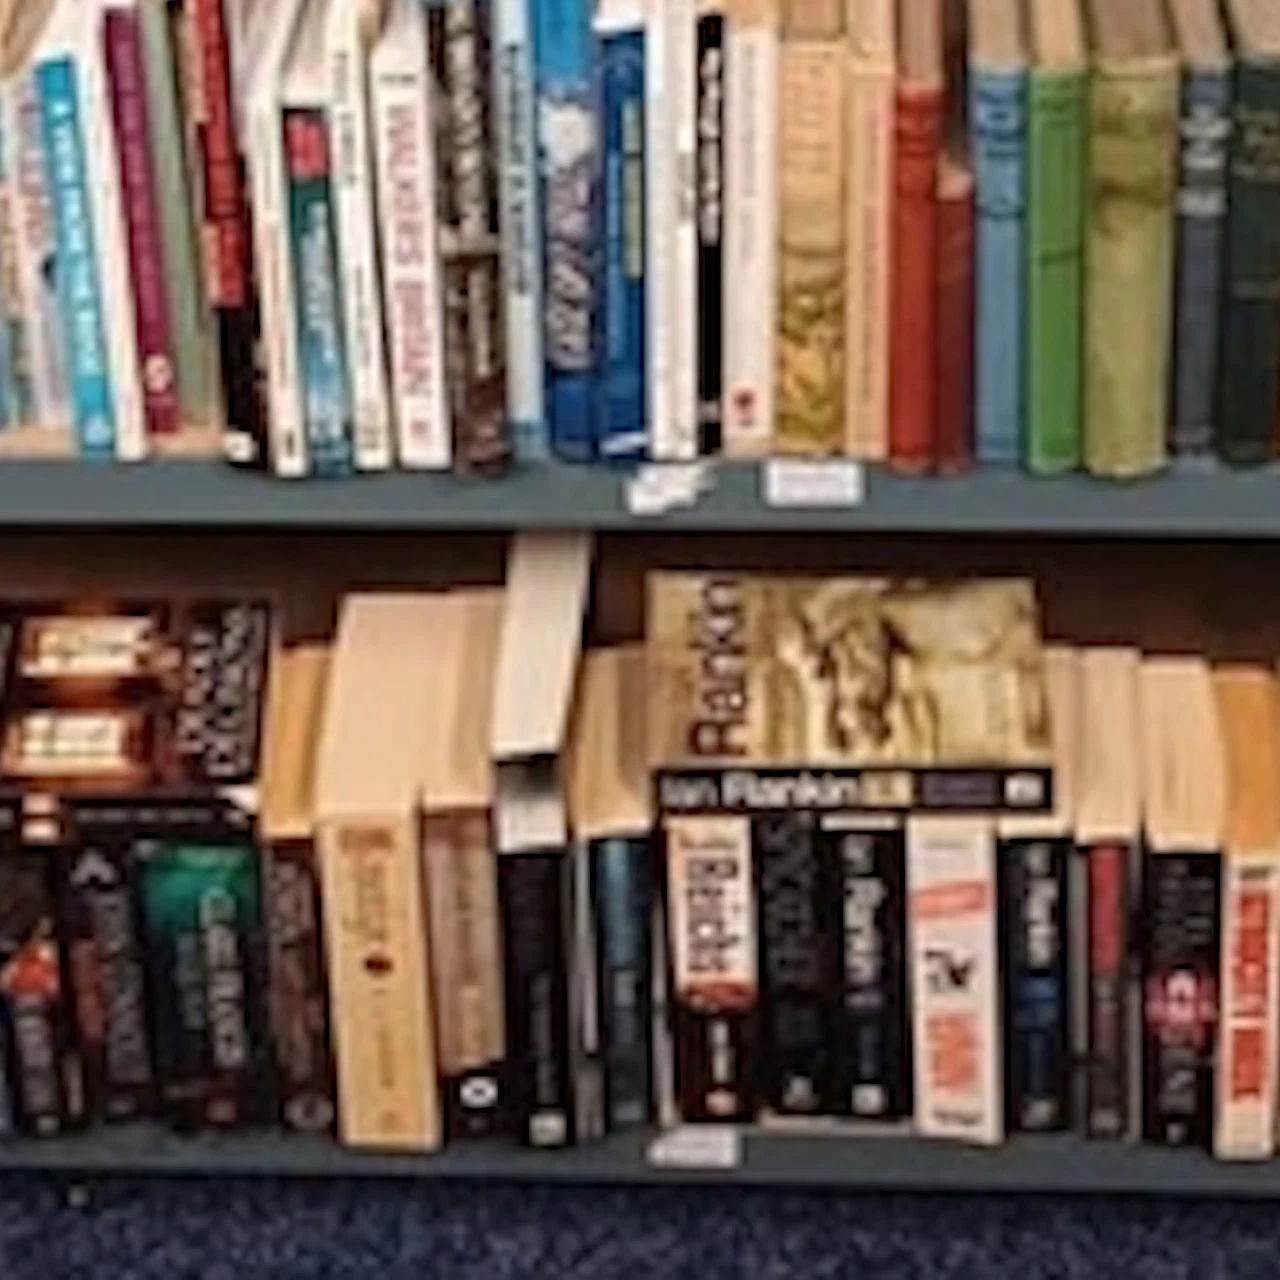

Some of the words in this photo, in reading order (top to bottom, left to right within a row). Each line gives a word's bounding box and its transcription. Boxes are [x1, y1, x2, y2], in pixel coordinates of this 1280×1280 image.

[690, 578, 750, 758] Rankin
[659, 776, 715, 810] Ian
[720, 768, 860, 809] Rankin
[842, 877, 888, 986] Rankin
